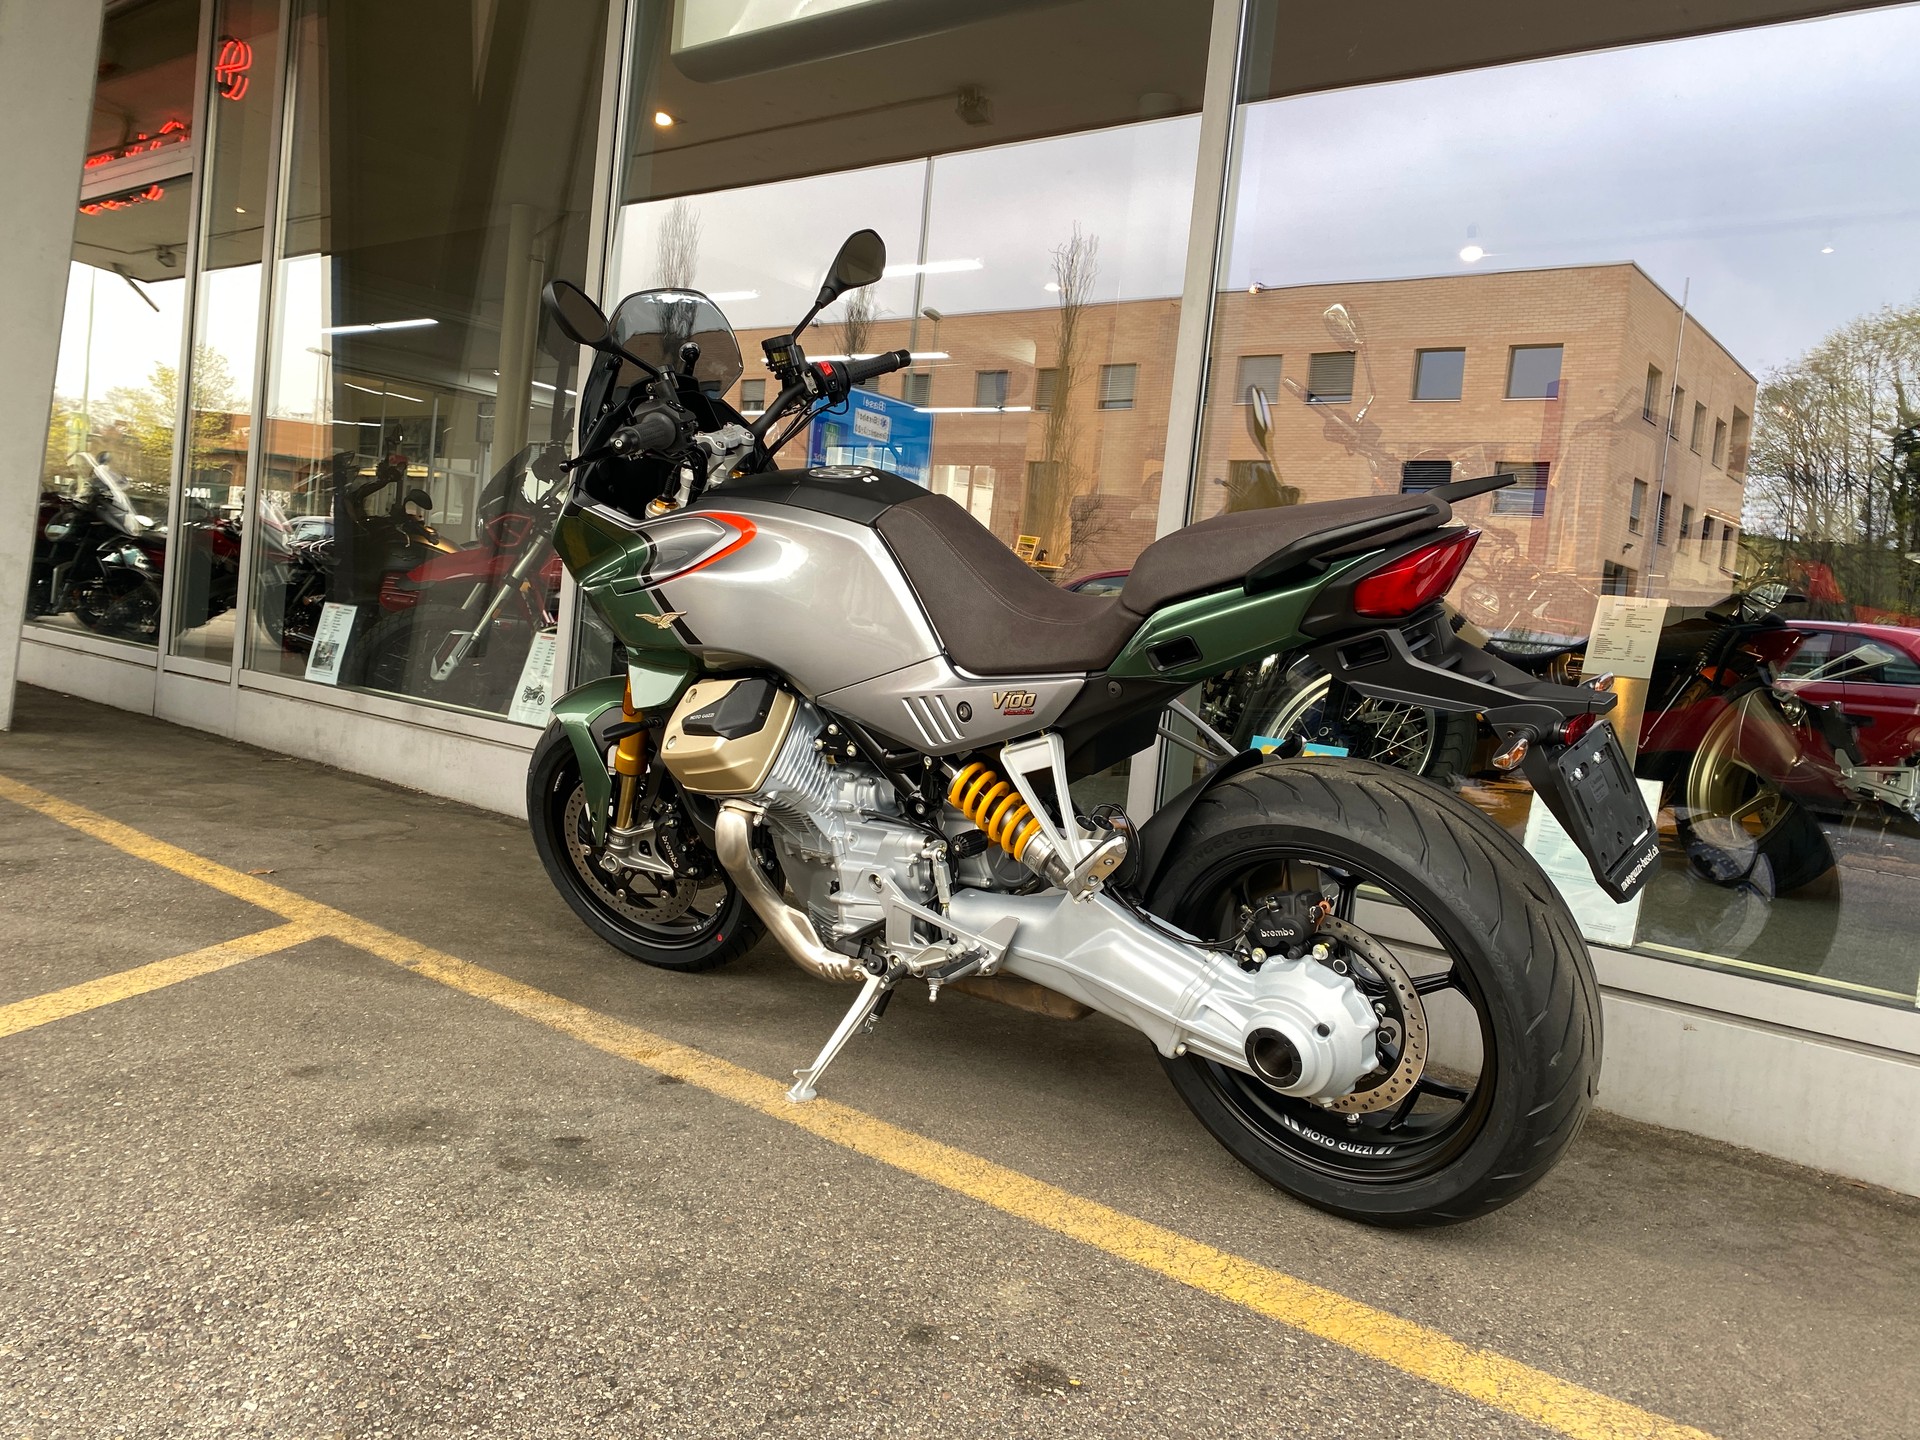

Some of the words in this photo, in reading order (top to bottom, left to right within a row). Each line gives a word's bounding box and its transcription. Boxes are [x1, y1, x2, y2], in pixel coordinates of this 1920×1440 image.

[992, 691, 1037, 709] V100
[661, 835, 679, 869] brembo
[1259, 927, 1295, 938] brembo
[1302, 1126, 1335, 1147] MOTO
[1338, 1142, 1374, 1155] GUZZI
